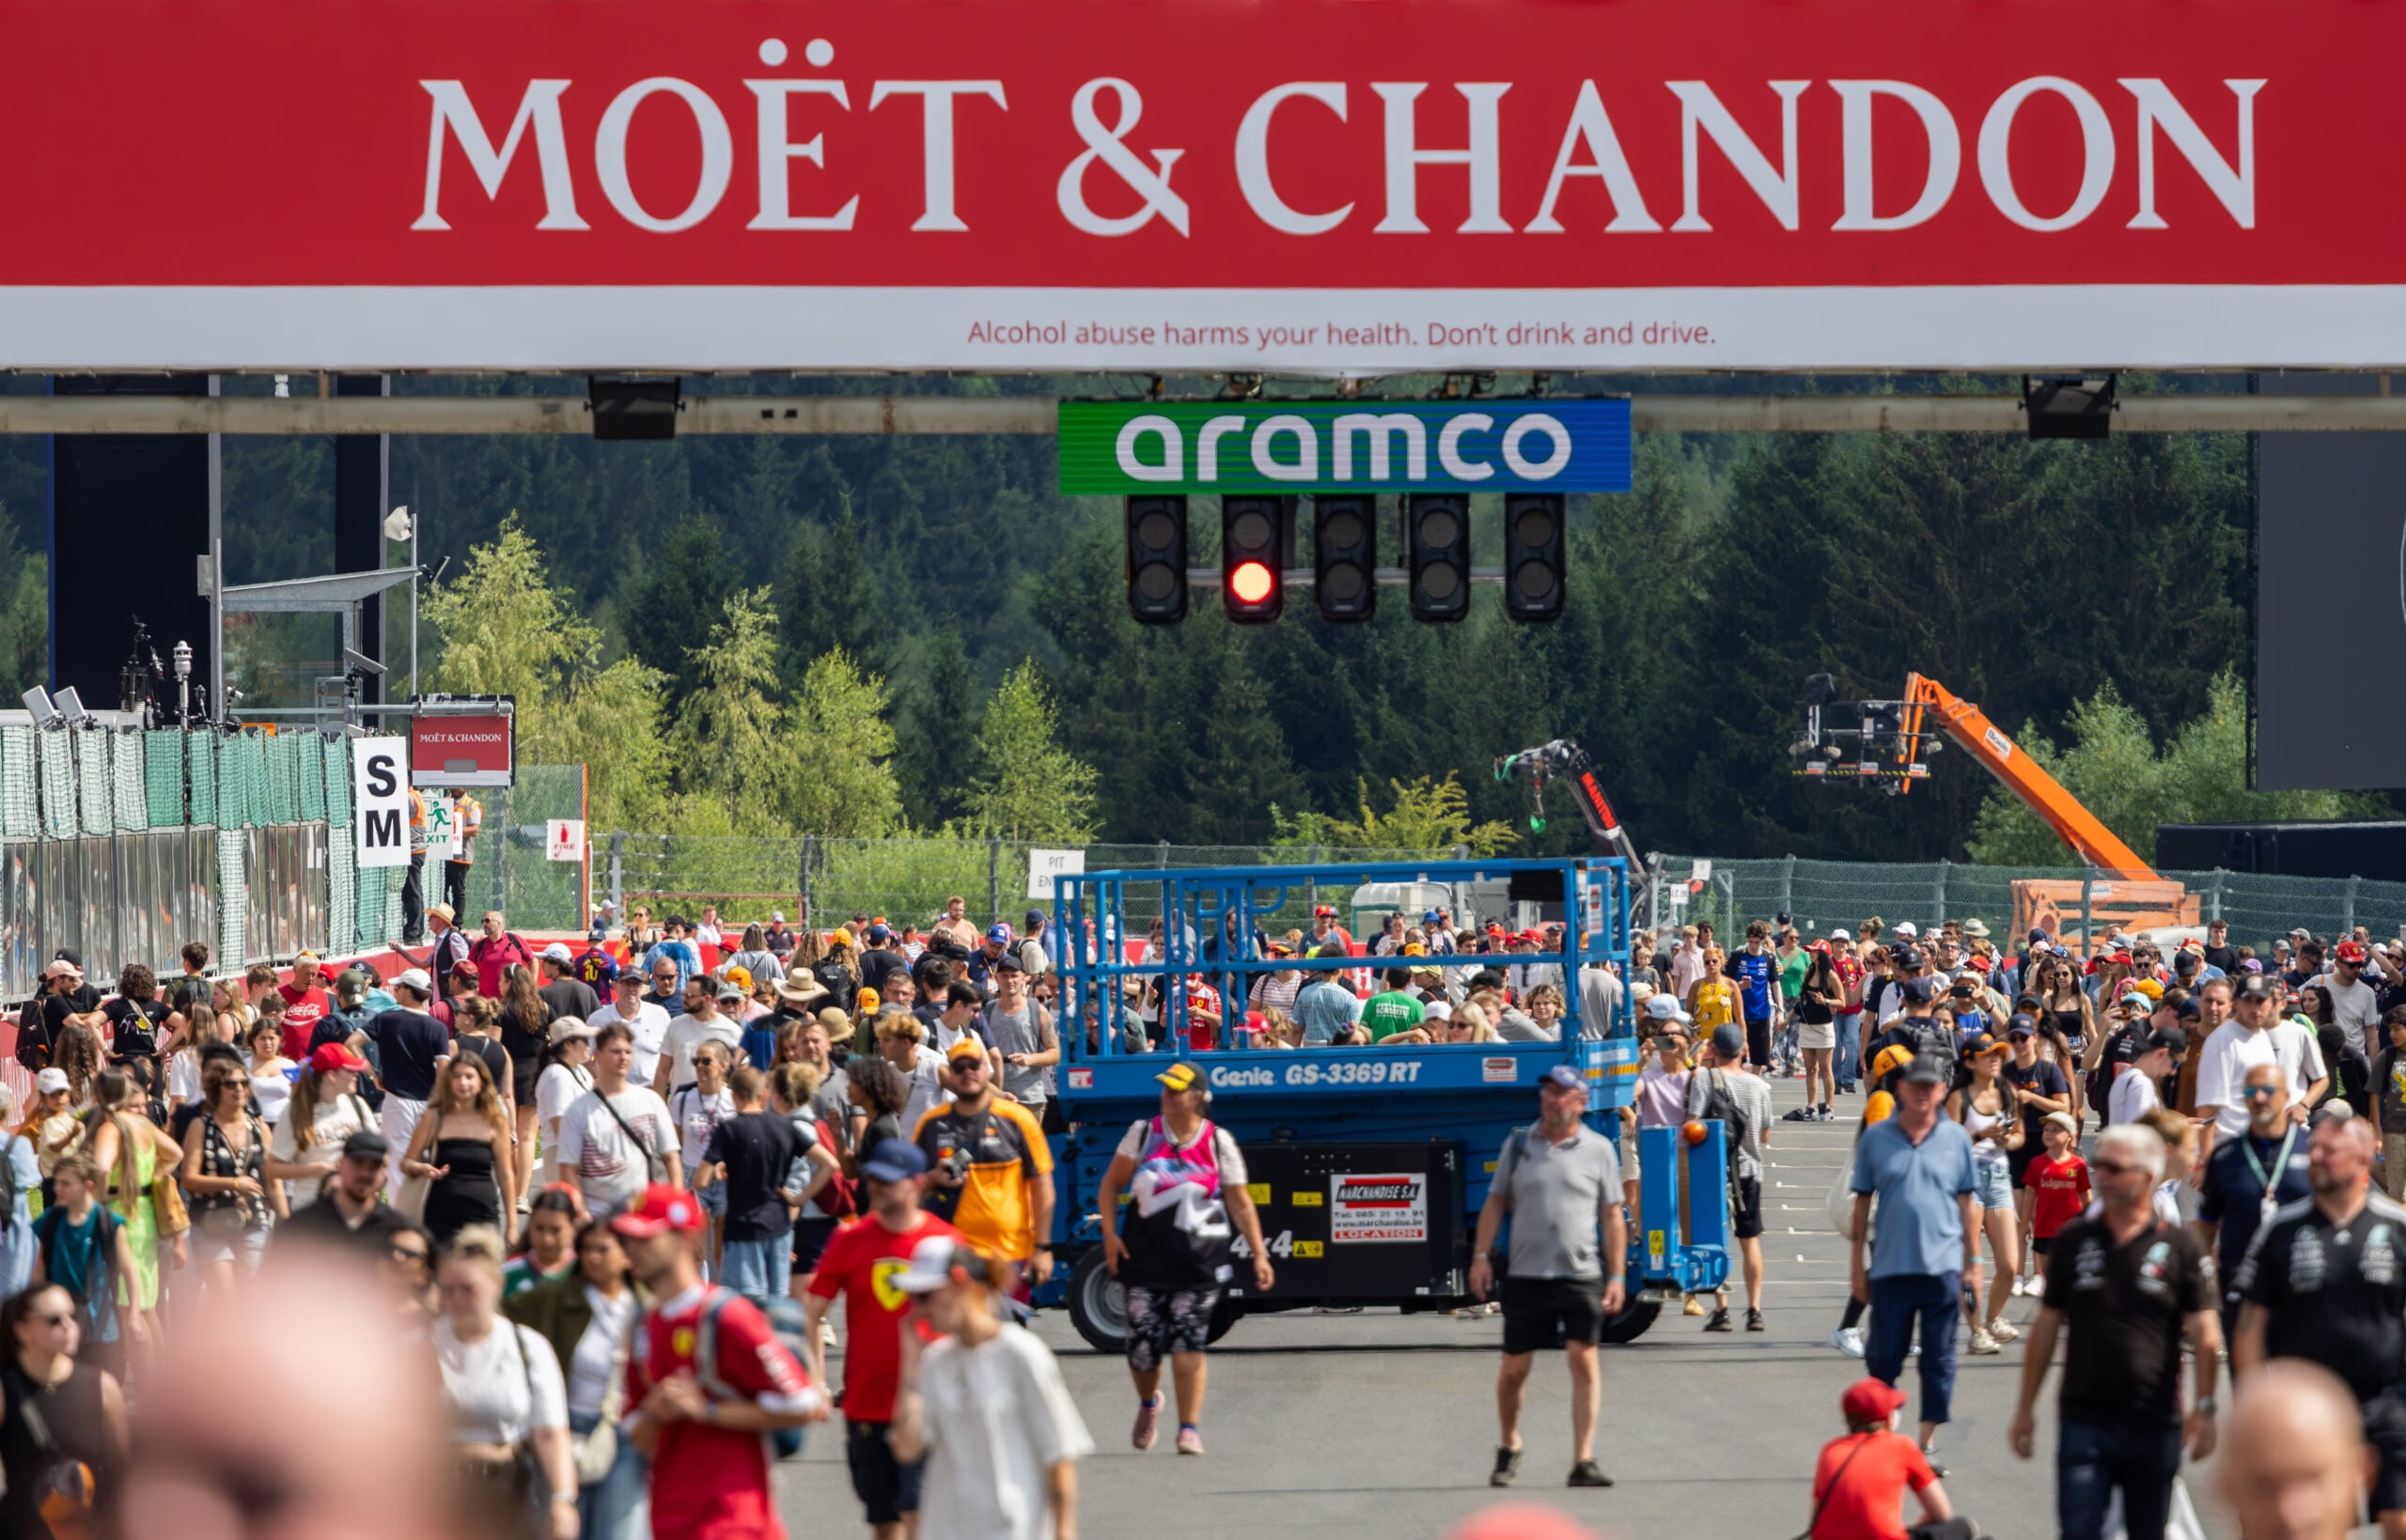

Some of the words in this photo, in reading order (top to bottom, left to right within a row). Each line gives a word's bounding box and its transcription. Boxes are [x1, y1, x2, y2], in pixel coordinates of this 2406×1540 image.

[411, 39, 1008, 233] MOËT
[1056, 77, 1190, 238] &
[1234, 75, 2268, 236] CHANDON
[968, 320, 1067, 344] Alcohol
[1075, 321, 1156, 345] abuse
[1164, 321, 1250, 345] harms
[1257, 327, 1318, 350] your
[1327, 322, 1418, 346] health.
[1506, 322, 1575, 345] drink
[1583, 321, 1633, 345] and
[1642, 321, 1716, 345] drive.
[1116, 412, 1571, 481] aramco
[419, 732, 445, 743] MOËT
[447, 733, 455, 742] &
[455, 733, 502, 742] CHANDON
[367, 754, 397, 798] S
[366, 809, 402, 848] M
[426, 834, 448, 844] XIT
[1049, 856, 1065, 869] PIT
[1211, 1066, 1274, 1087] Genie
[1285, 1062, 1387, 1085] GS-3369
[1389, 1062, 1422, 1082] RT
[1338, 1229, 1419, 1239] LOCATION
